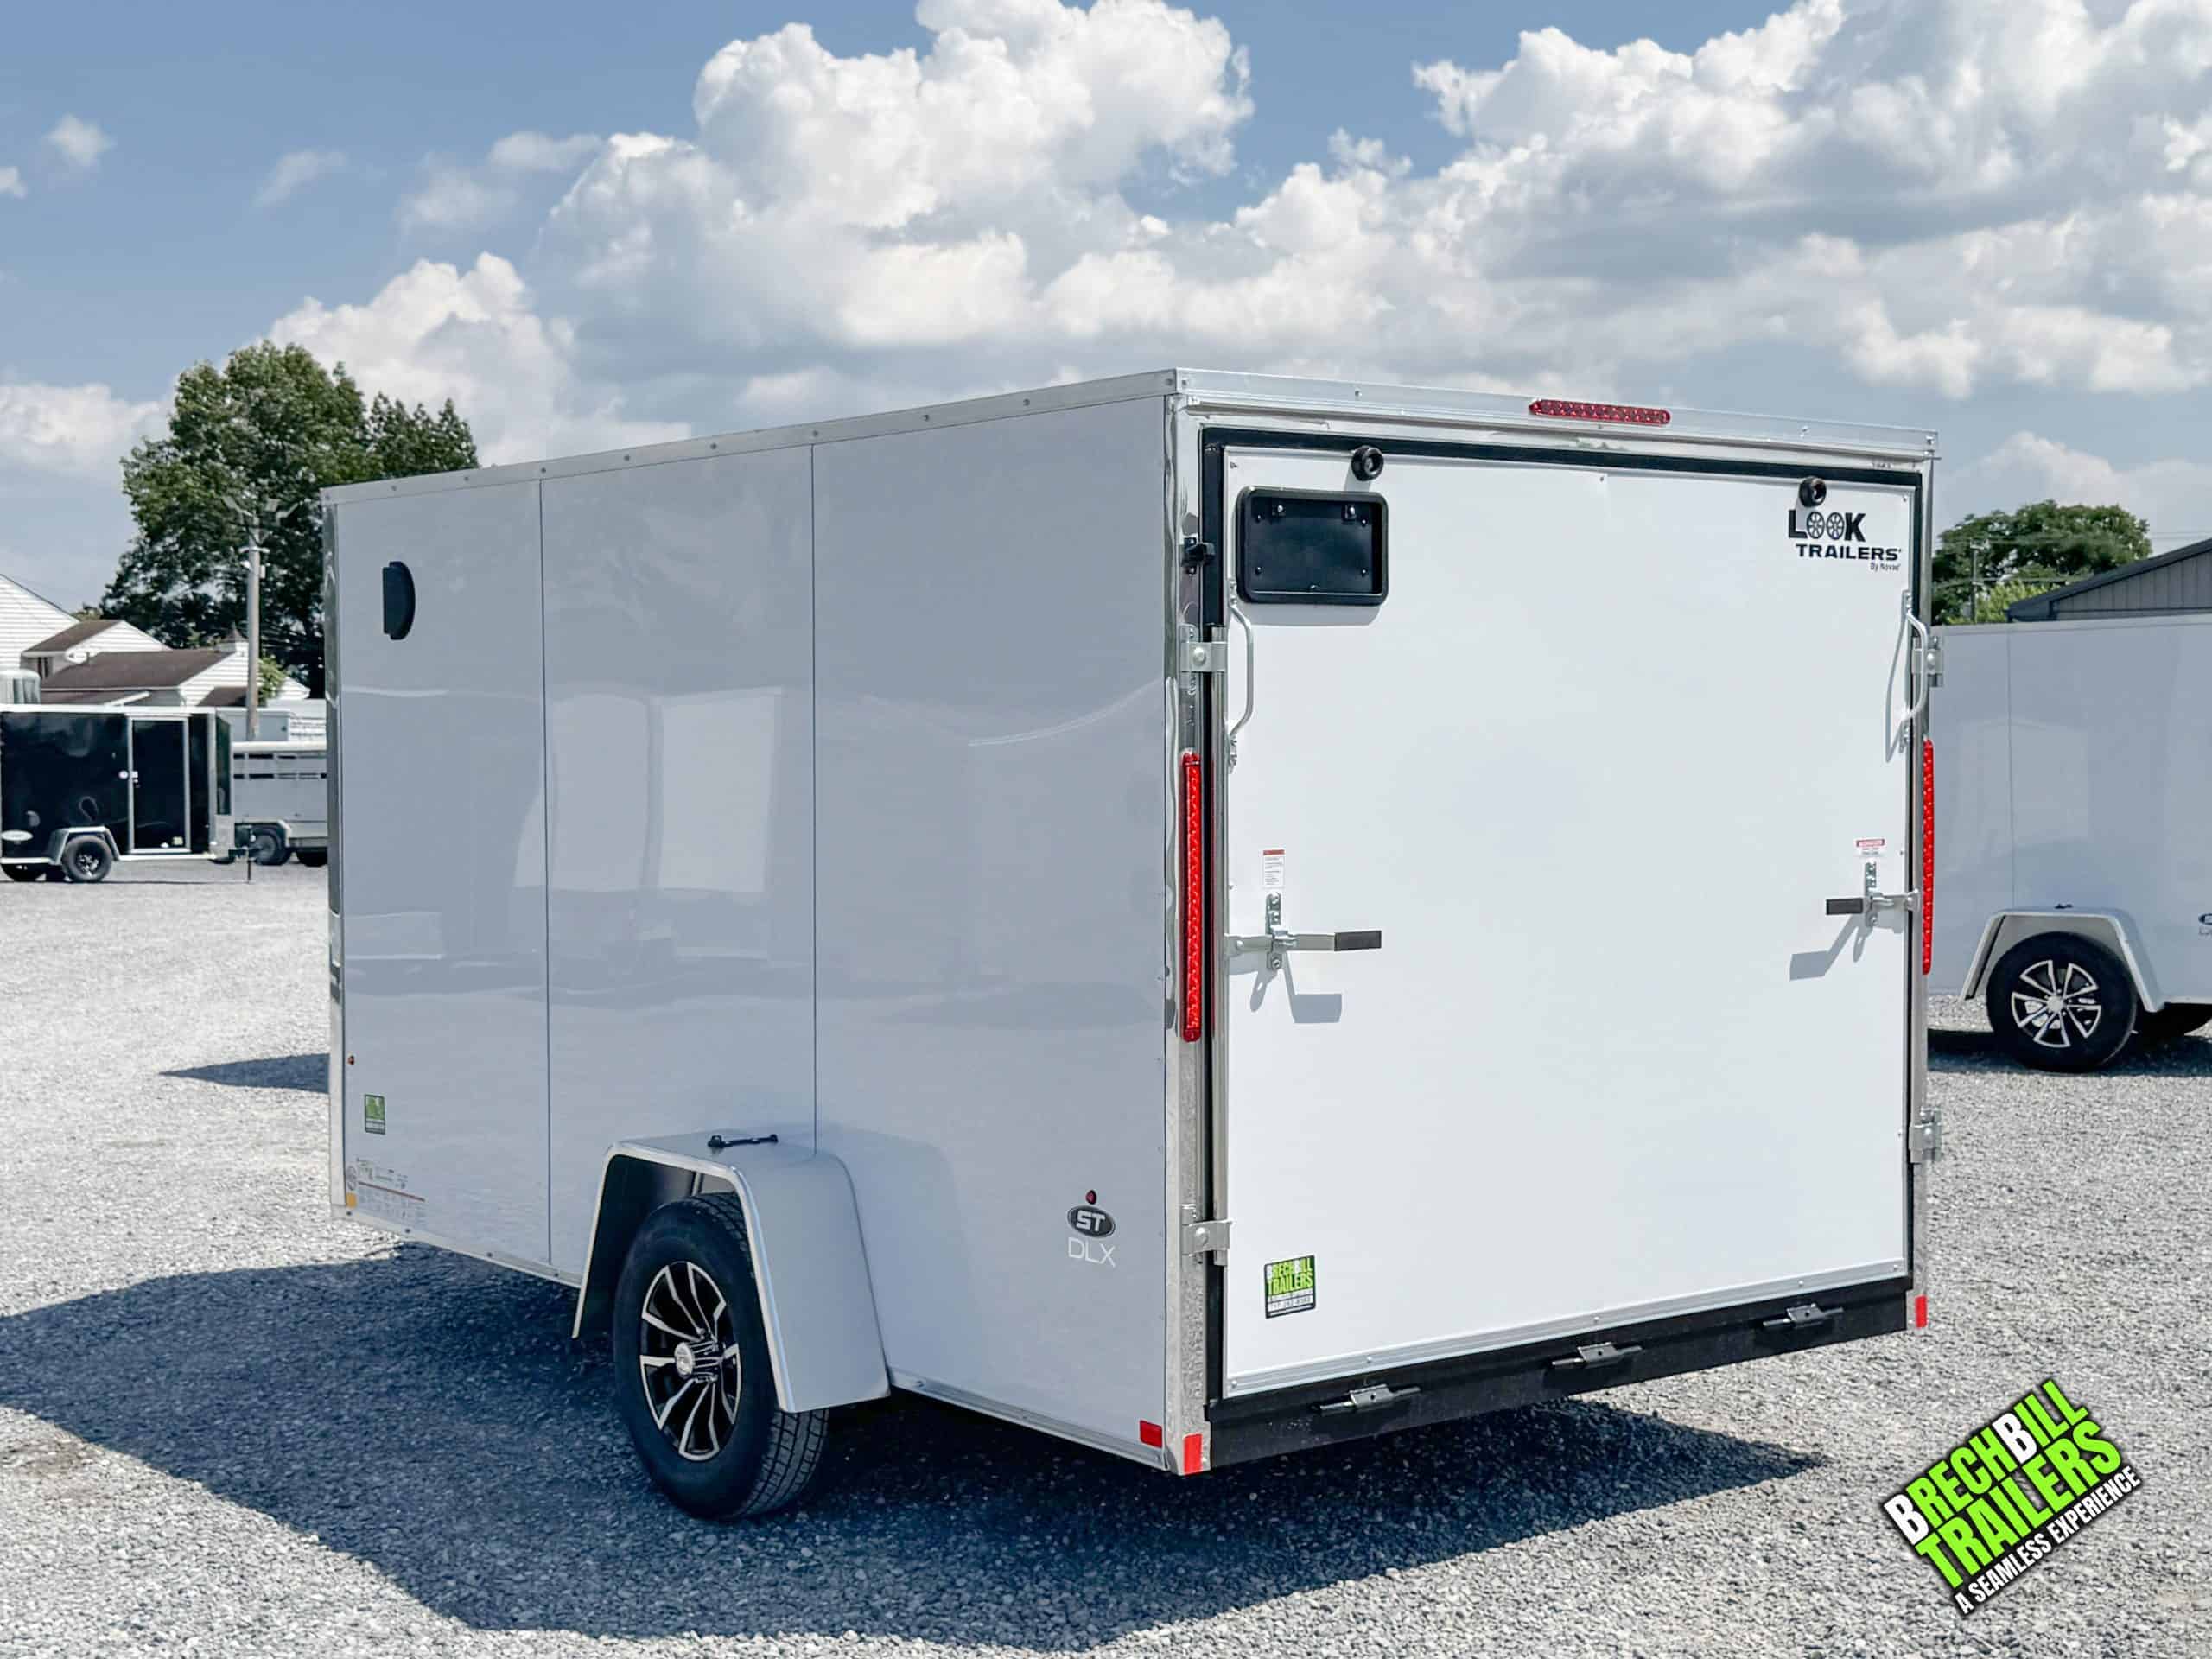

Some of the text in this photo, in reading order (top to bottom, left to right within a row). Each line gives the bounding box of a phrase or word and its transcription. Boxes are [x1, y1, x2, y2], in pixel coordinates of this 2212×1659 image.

[1789, 509, 1866, 543] LOOK
[1796, 543, 1898, 561] TRAILERS
[1076, 1210, 1106, 1232] ST
[1068, 1236, 1116, 1268] DLX
[1268, 1271, 1313, 1295] TRAILERS
